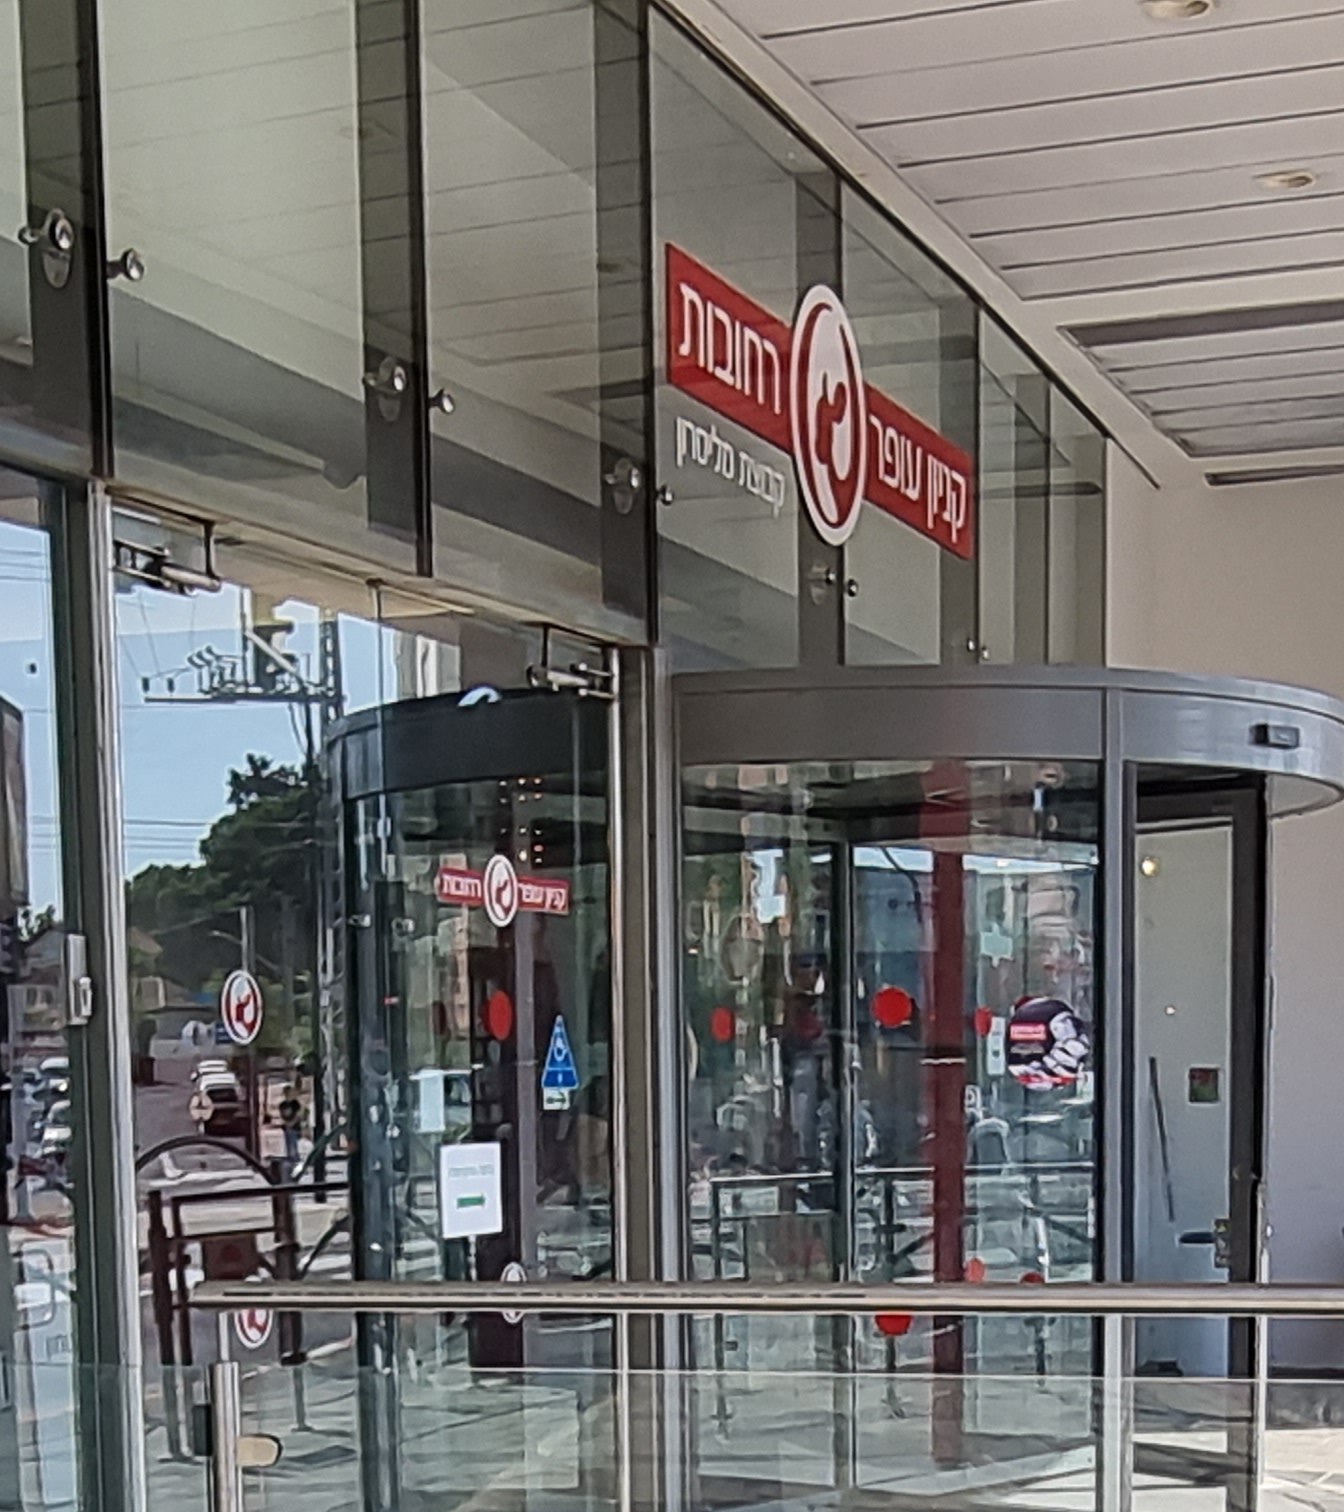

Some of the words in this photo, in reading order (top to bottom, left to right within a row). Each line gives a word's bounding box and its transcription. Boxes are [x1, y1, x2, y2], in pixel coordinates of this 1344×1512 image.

[678, 282, 783, 416] רחובות
[675, 416, 735, 480] מליסרון
[739, 450, 785, 519] קבוצת
[869, 412, 923, 504] עופר
[926, 452, 969, 544] קניון
